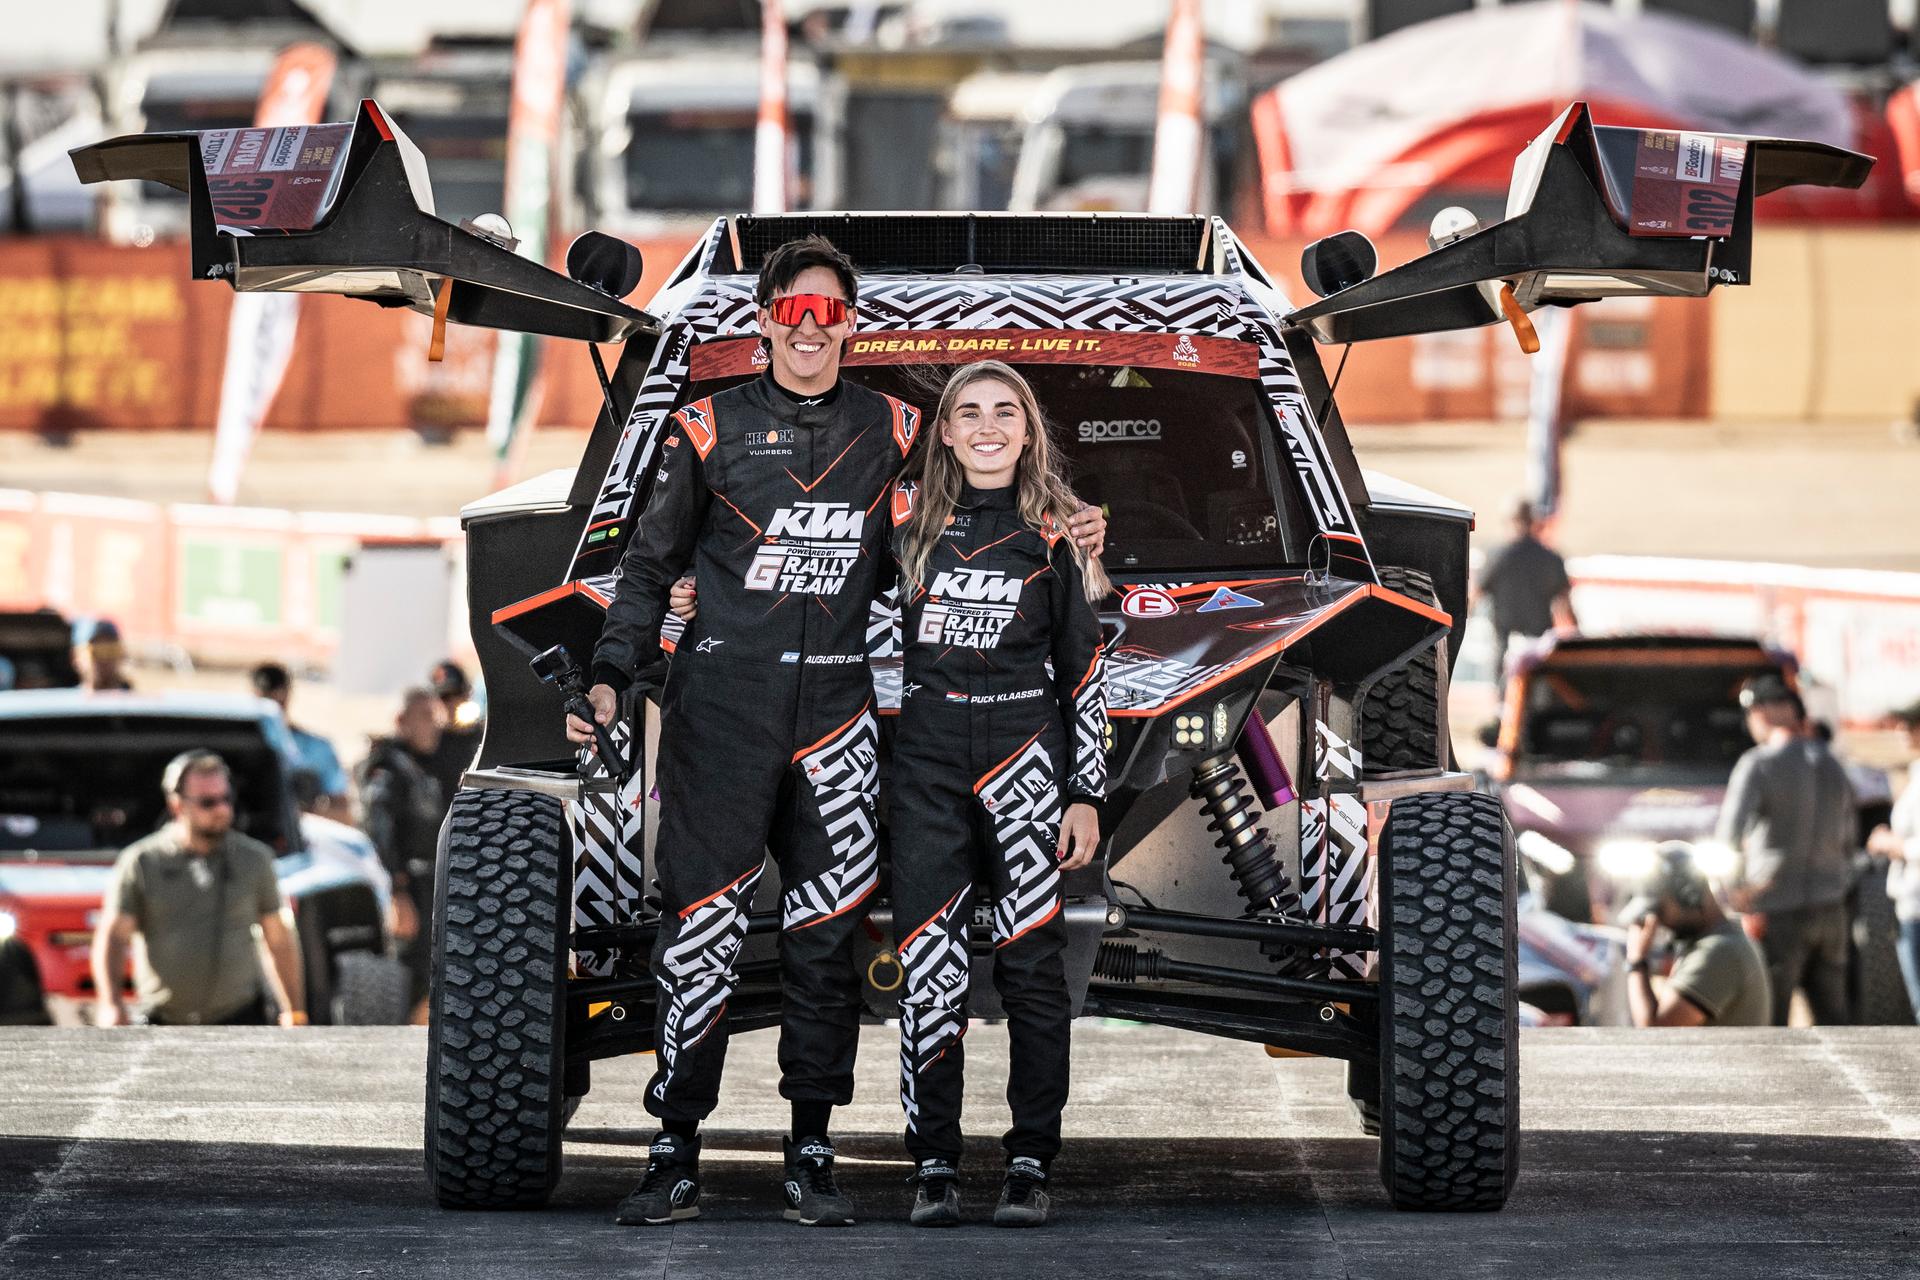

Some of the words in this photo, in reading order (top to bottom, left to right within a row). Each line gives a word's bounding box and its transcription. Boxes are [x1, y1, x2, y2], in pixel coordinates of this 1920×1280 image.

[203, 138, 225, 165] TUDOR
[232, 131, 263, 168] MOTUL
[1684, 138, 1703, 177] BFGoodrich
[1720, 146, 1746, 180] MOTUL
[208, 178, 274, 220] 302
[1685, 189, 1737, 230] 302
[853, 340, 942, 354] DREAM.
[947, 338, 1015, 351] DARE.
[1020, 338, 1072, 351] LIVE
[1075, 339, 1102, 352] IT.
[1172, 351, 1201, 363] DAKAR
[1078, 418, 1162, 443] sparco
[764, 501, 866, 539] KTM
[786, 548, 826, 557] POWERED
[782, 556, 858, 577] RALLY
[779, 574, 846, 595] TEAM
[928, 567, 1024, 603] KTM
[947, 608, 981, 616] POWERED
[944, 615, 1013, 633] RALLY
[944, 630, 1001, 649] TEAM
[805, 655, 845, 664] AUGUSTO
[970, 695, 994, 704] PUCK
[996, 688, 1044, 702] KLAASSEN
